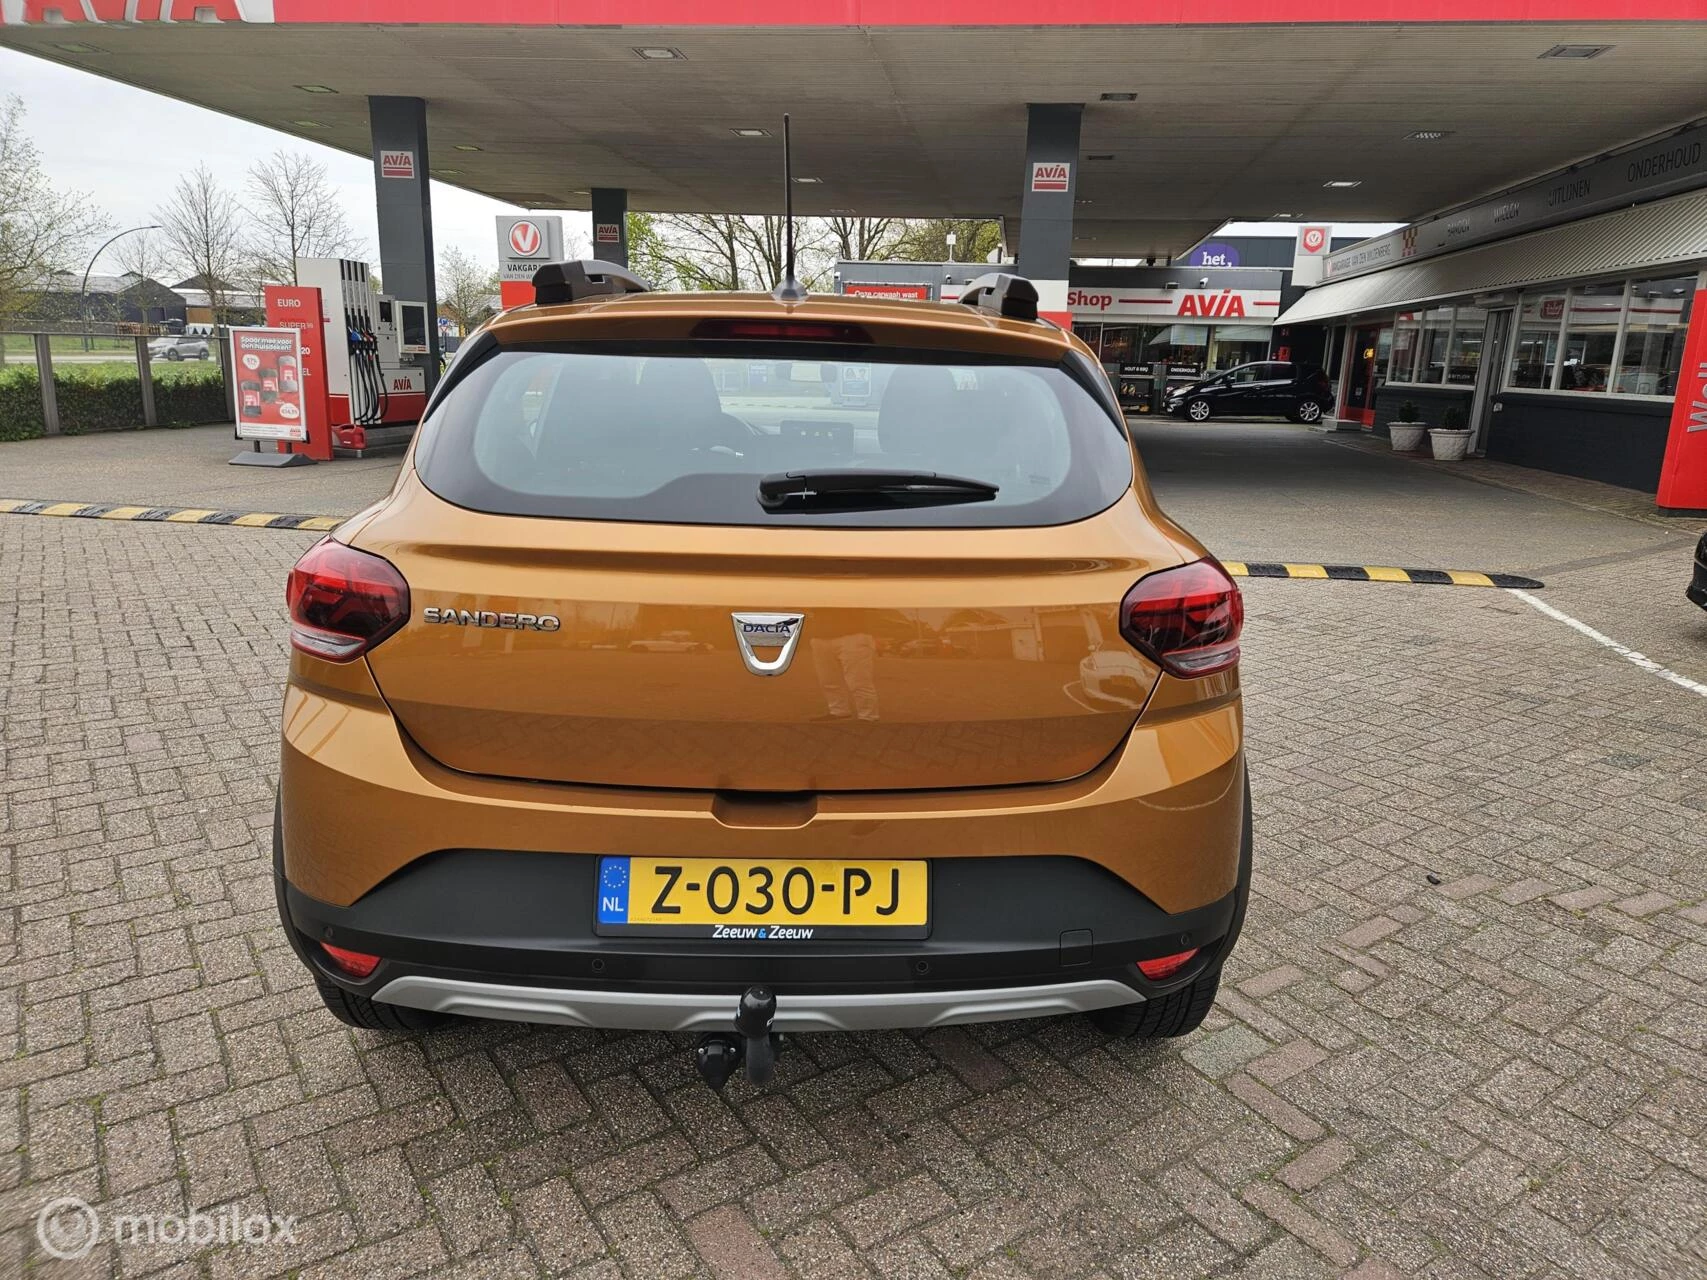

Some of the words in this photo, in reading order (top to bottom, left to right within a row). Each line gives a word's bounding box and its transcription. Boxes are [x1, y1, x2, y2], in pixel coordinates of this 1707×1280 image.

[383, 152, 412, 165] AVIA
[1628, 142, 1701, 182] ONDERHOUD
[1035, 164, 1067, 178] AVIA
[598, 225, 618, 234] AVIA
[1202, 251, 1226, 265] het
[278, 299, 301, 307] EURO
[1067, 290, 1113, 311] Shop
[1177, 289, 1246, 318] AVIA
[393, 376, 412, 390] AVIA
[424, 607, 560, 632] SANDERO
[743, 624, 791, 634] DACIA
[651, 866, 900, 915] Z-030-PJ
[602, 897, 624, 912] NL
[712, 924, 758, 940] Zeeuw
[768, 925, 814, 940] Zeeuw
